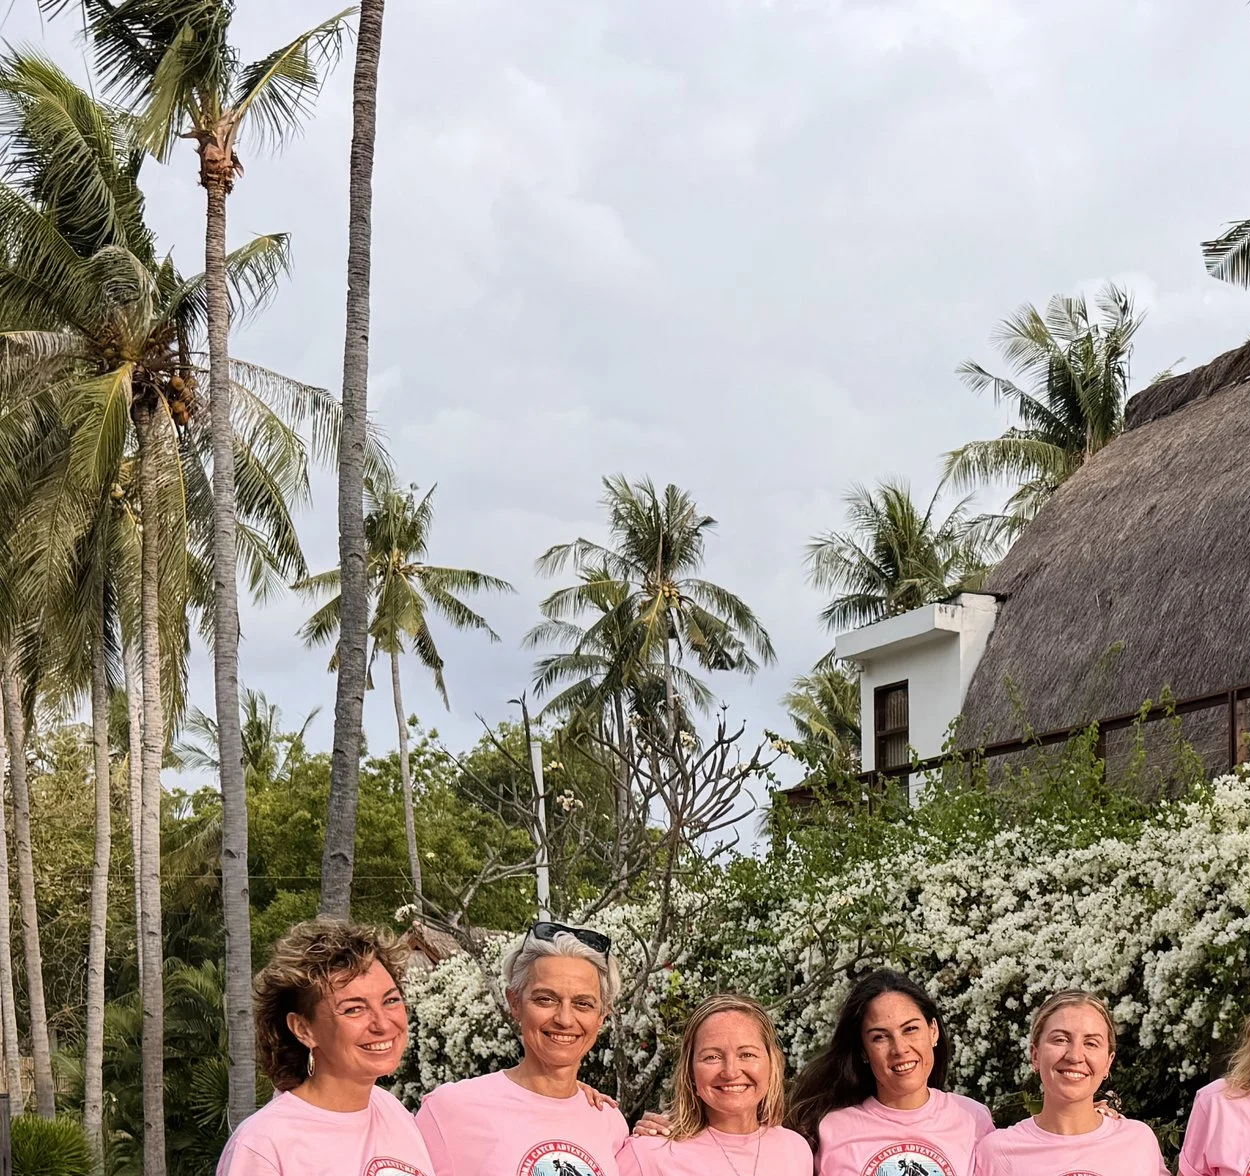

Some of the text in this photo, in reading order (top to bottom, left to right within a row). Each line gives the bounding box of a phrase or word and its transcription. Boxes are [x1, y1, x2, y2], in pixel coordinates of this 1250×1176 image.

[532, 1144, 554, 1158] CATCH
[556, 1144, 597, 1170] ADVENTURE
[878, 1145, 902, 1160] CATCH
[904, 1144, 946, 1166] ADVENTURE
